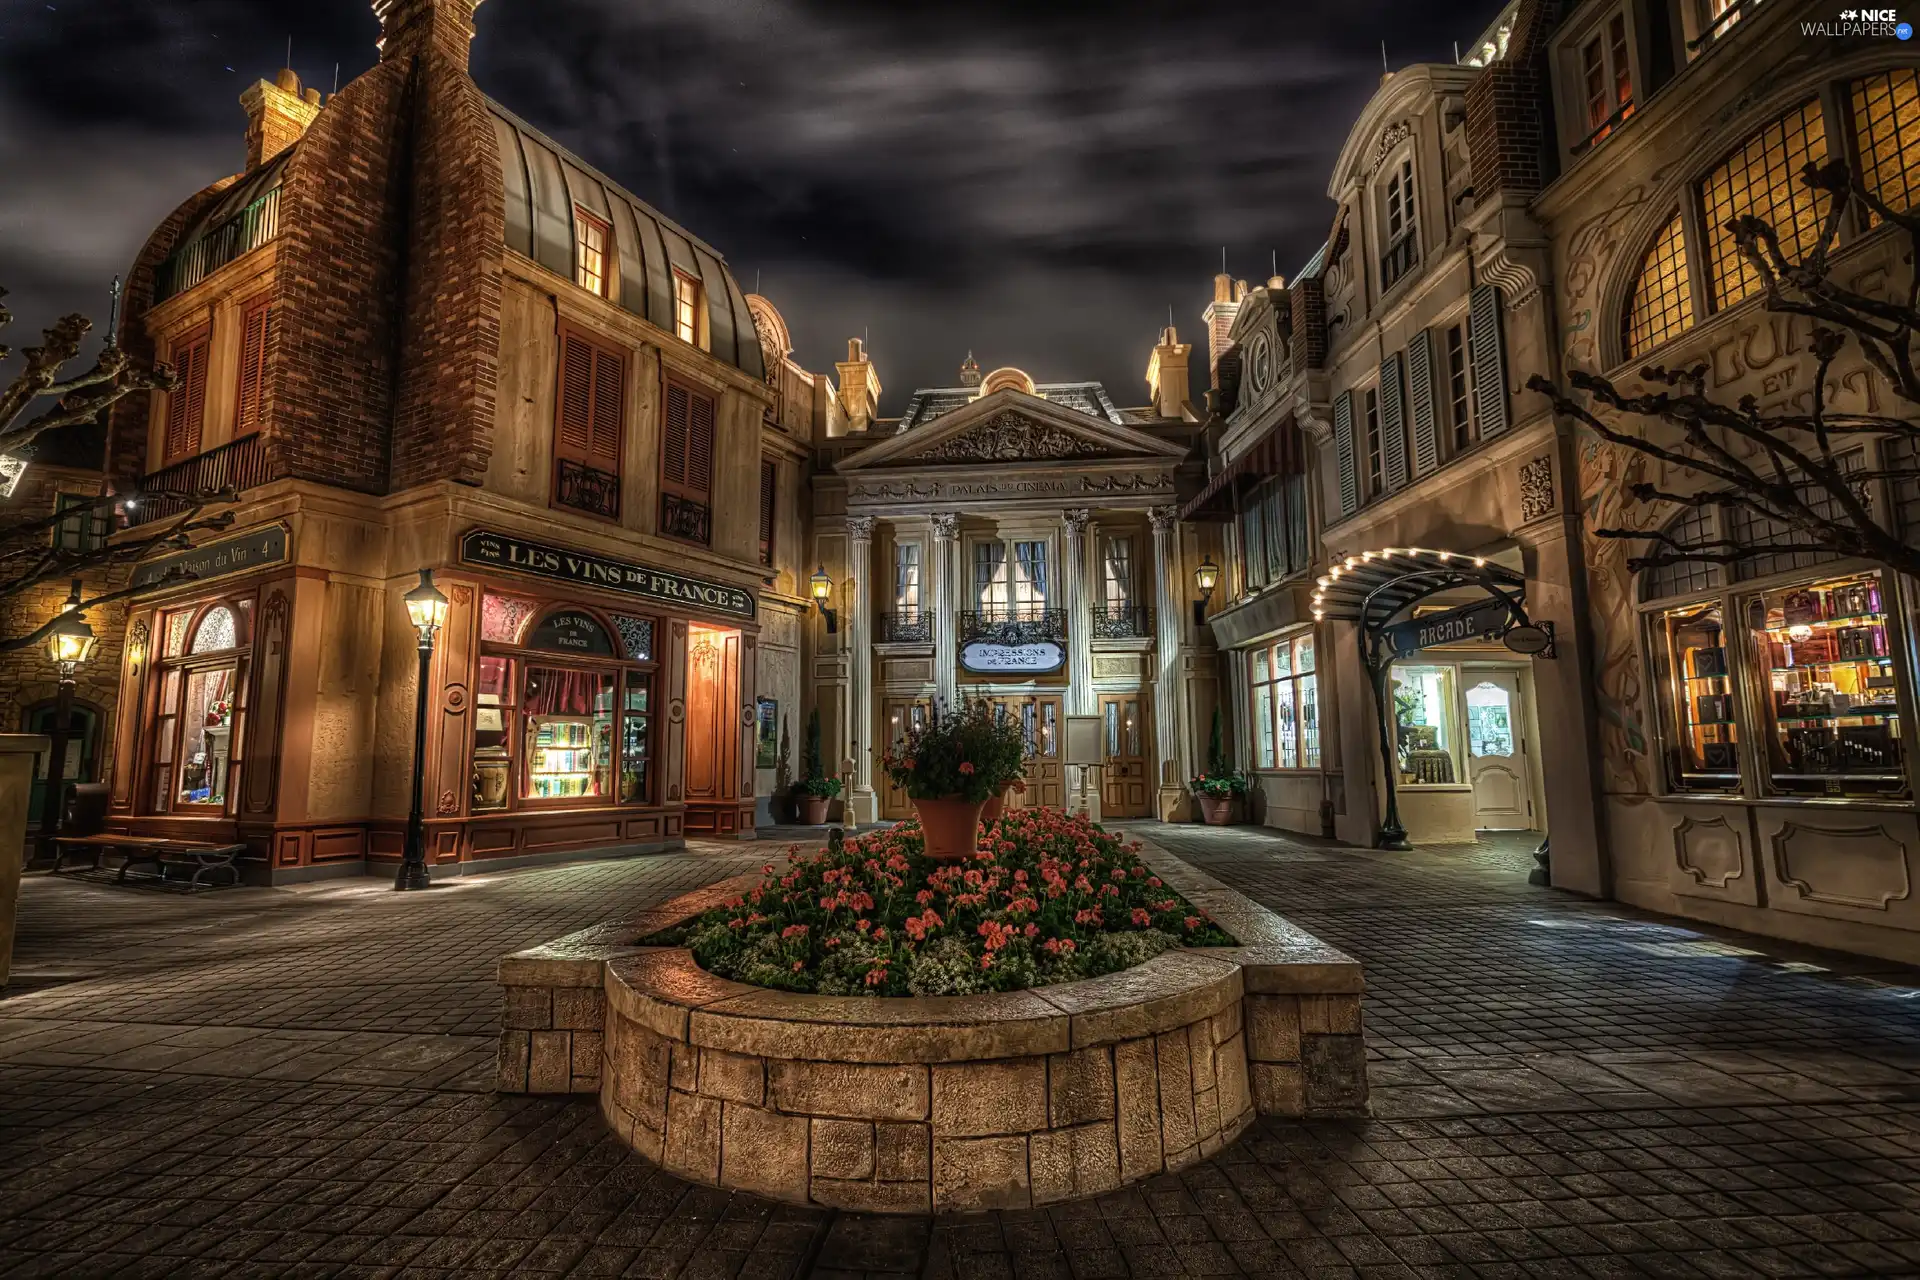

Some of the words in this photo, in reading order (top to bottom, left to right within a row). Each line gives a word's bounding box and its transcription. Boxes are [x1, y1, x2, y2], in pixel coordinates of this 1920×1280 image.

[1762, 365, 1796, 397] ET
[952, 483, 998, 495] PALAIS
[1016, 480, 1067, 492] CINEMA
[480, 540, 501, 550] VINS
[215, 552, 227, 567] du
[231, 547, 247, 563] Vin
[261, 540, 269, 558] 4
[480, 548, 501, 558] FINS
[508, 544, 560, 571] LES
[565, 556, 622, 584] VINS
[625, 570, 647, 585] DE
[650, 576, 729, 606] FRANCE
[553, 617, 572, 628] LES
[573, 617, 595, 632] VINS
[1419, 616, 1475, 646] ARCADE
[558, 637, 588, 647] FRANCE
[979, 648, 1047, 658] IMPRESSIONS
[998, 657, 1038, 665] FRANCE
